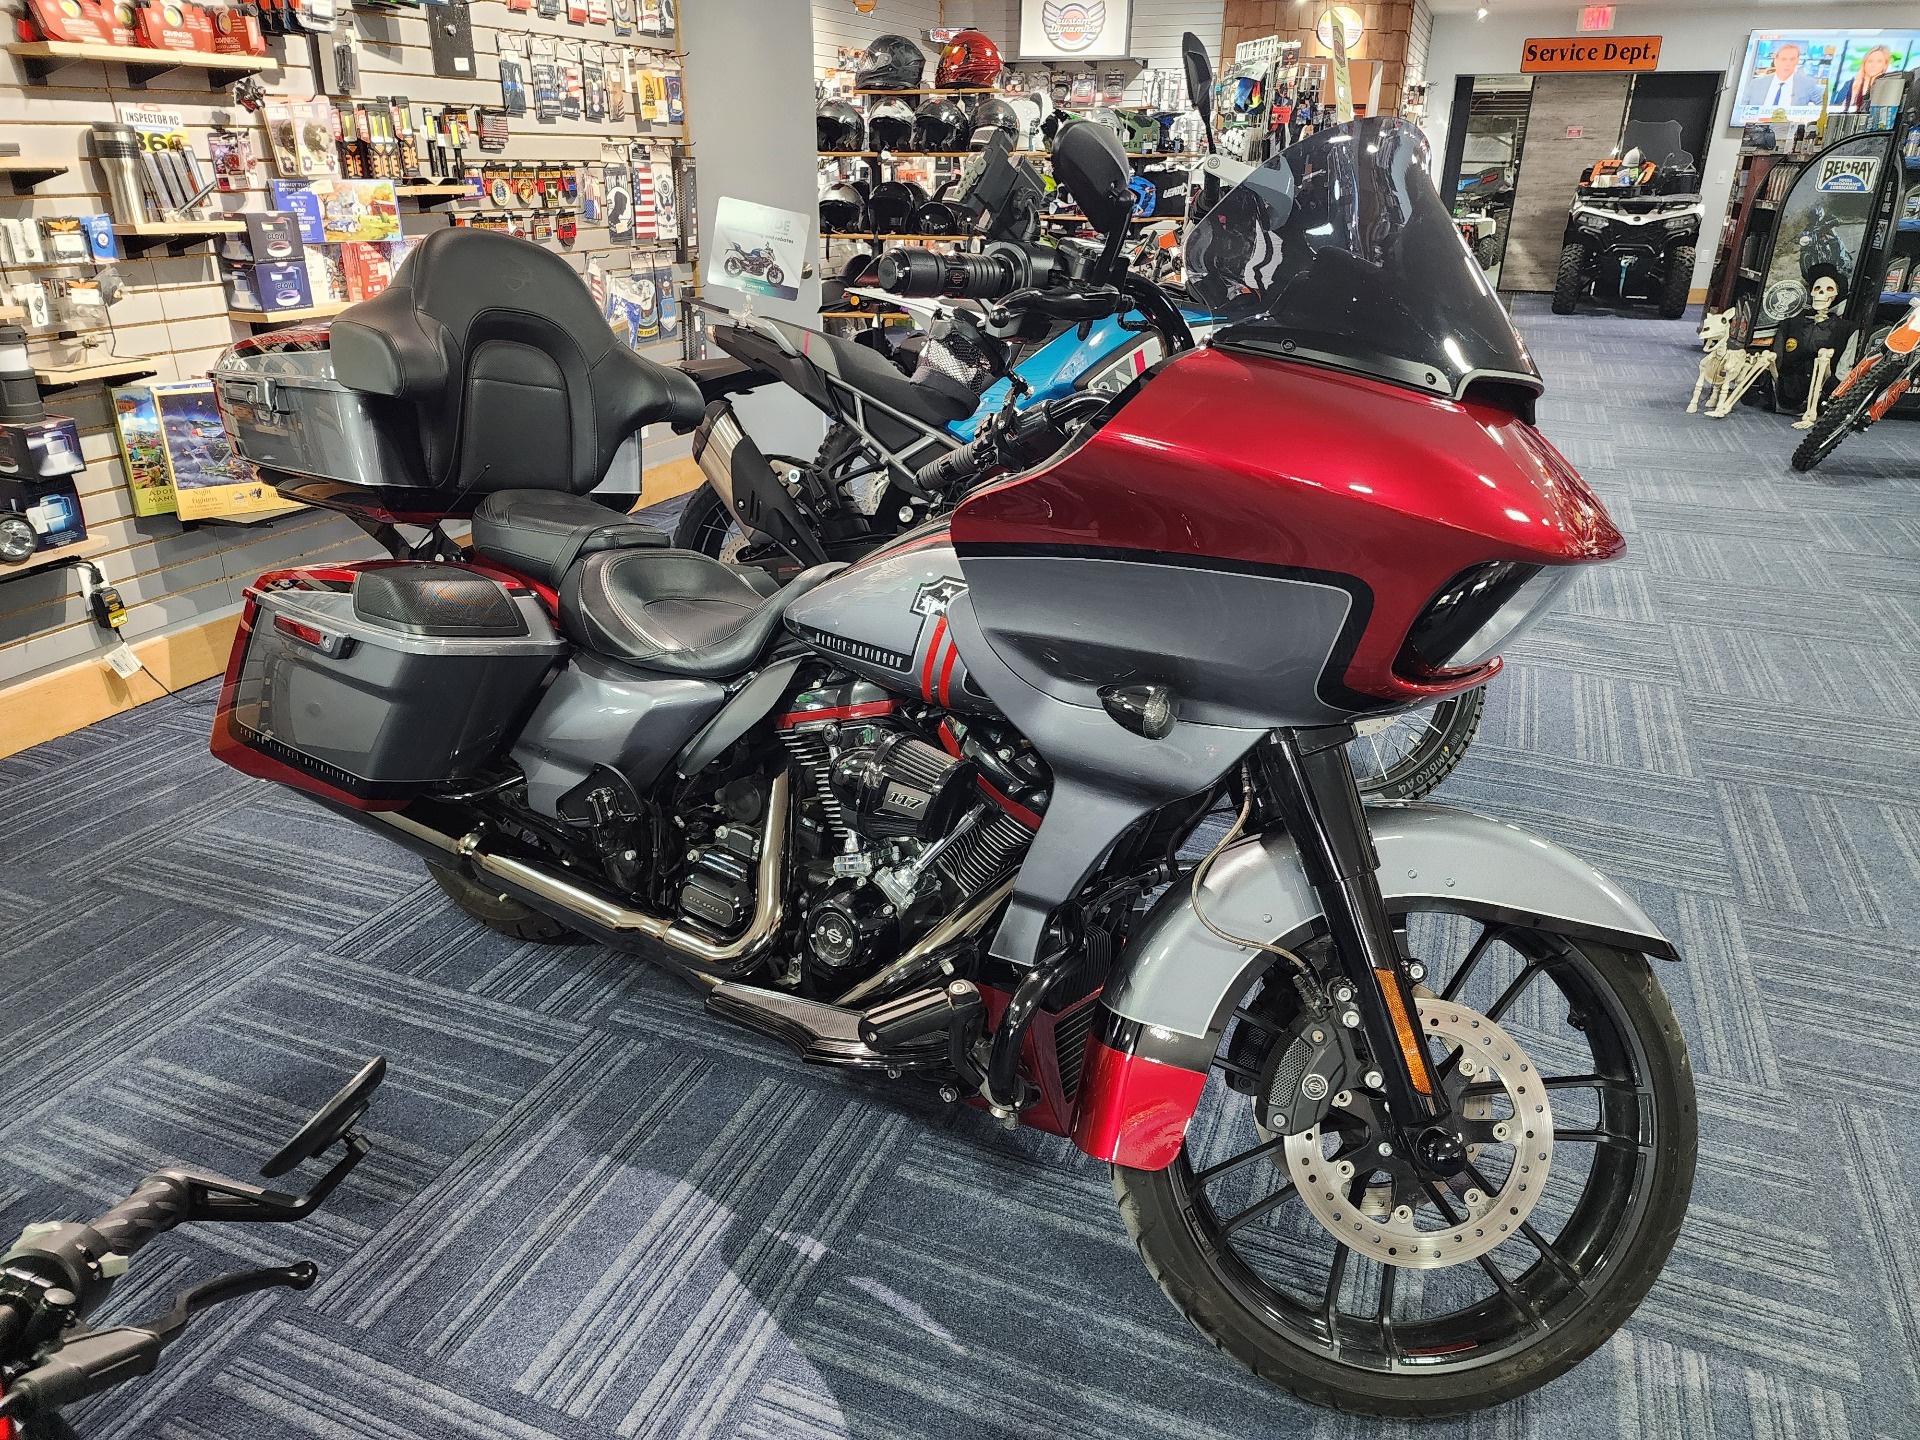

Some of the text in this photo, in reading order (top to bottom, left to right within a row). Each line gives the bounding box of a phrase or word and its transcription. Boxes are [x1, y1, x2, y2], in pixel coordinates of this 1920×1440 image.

[1057, 16, 1092, 25] Custom
[1583, 6, 1612, 30] EXIT
[1050, 24, 1097, 34] Dynamics
[1525, 42, 1656, 65] Service Dept.
[125, 111, 180, 126] INSPECTOR RC
[276, 282, 294, 290] GLOW
[191, 496, 218, 505] Fighters
[815, 632, 903, 668] HARLEY-DAVIDSON
[1397, 748, 1452, 795] AMBRO A4
[887, 791, 926, 810] 117
